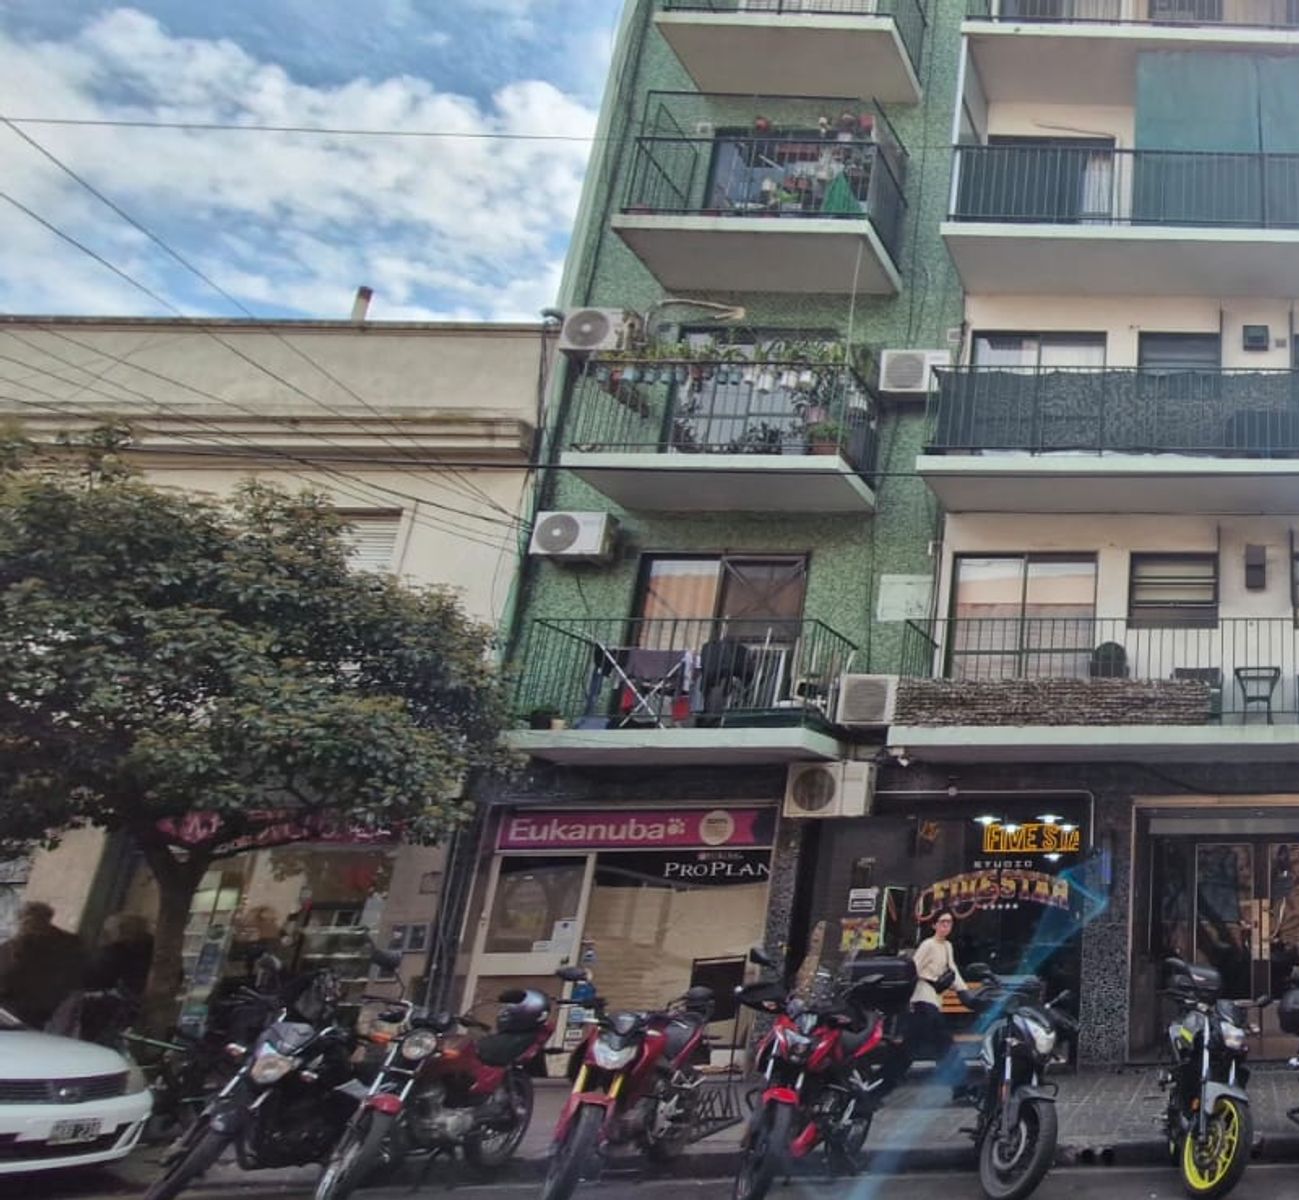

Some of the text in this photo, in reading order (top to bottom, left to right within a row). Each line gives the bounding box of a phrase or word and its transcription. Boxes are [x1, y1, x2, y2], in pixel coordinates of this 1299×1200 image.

[509, 818, 664, 841] Eukanuba
[986, 824, 1038, 850] FIVE
[932, 869, 1070, 910] FIVE STAR
